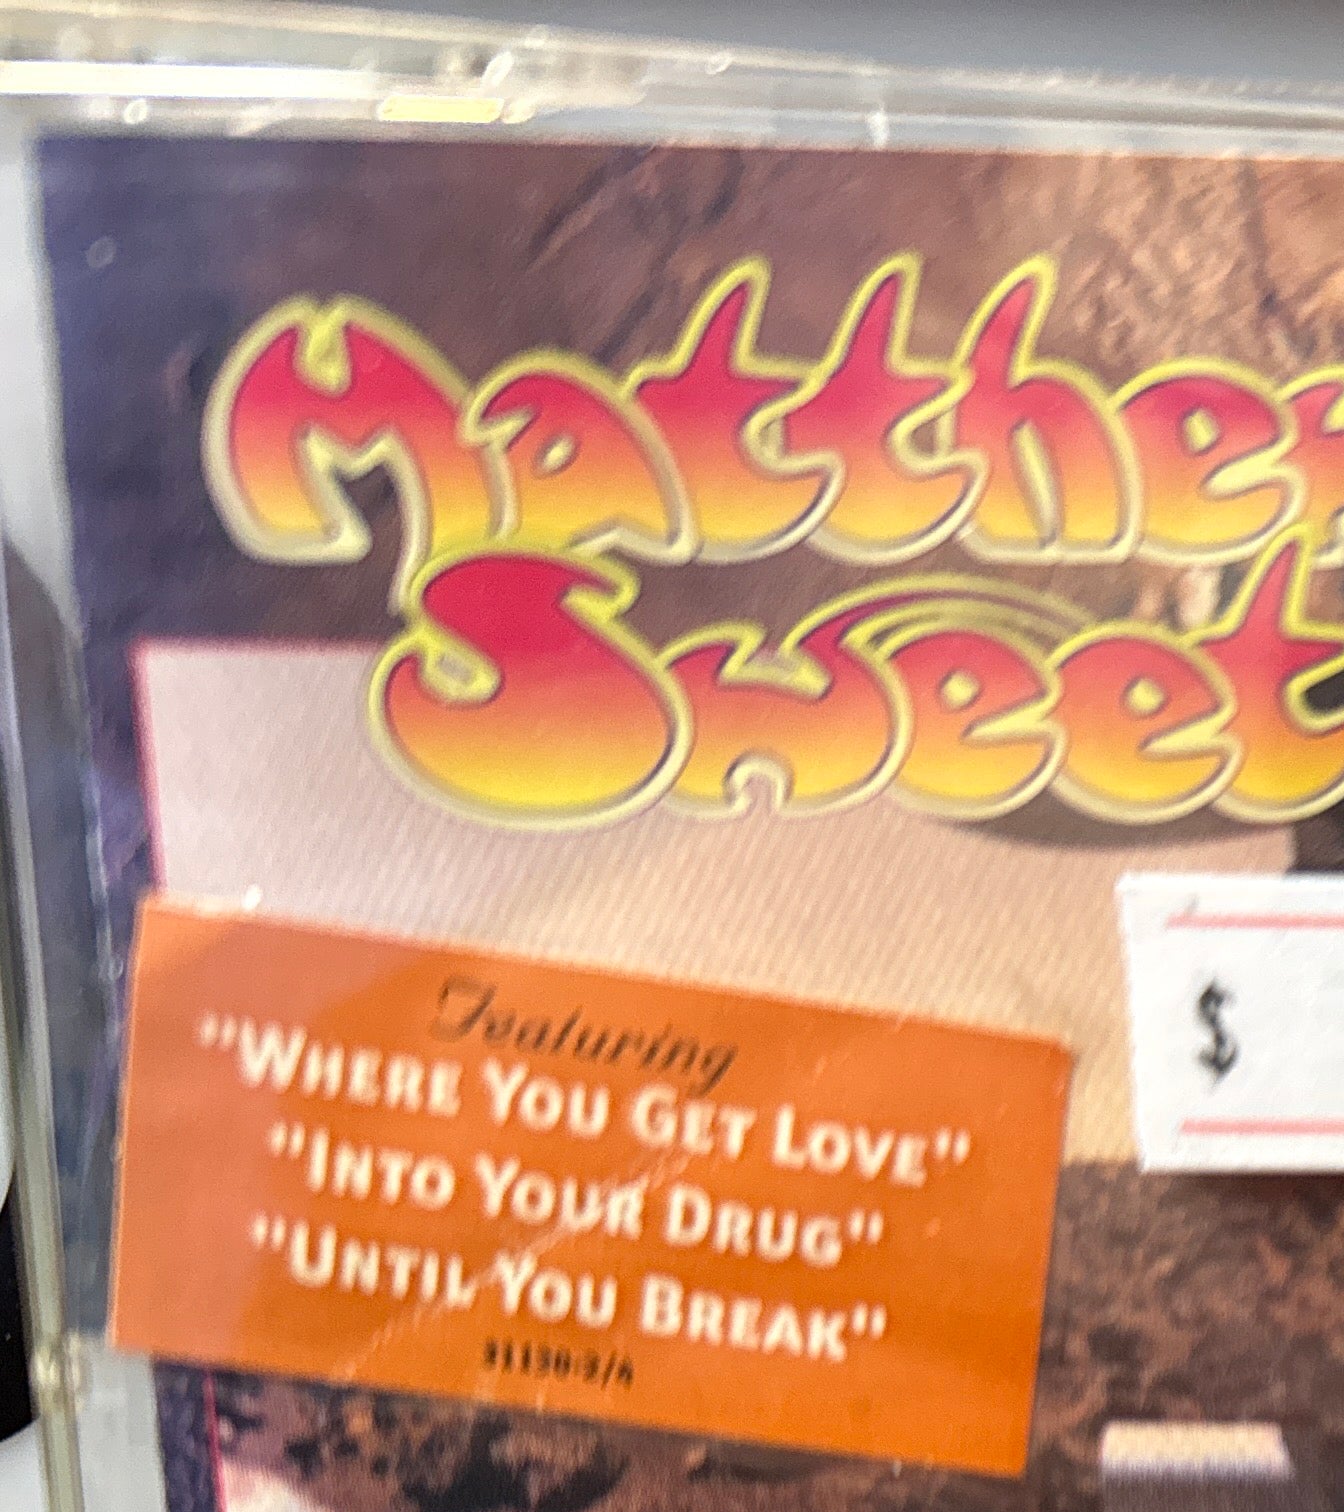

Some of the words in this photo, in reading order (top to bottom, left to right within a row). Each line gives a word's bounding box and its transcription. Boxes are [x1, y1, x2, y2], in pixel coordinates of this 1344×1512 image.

[428, 975, 740, 1097] Featuring
[1197, 976, 1239, 1083] $
[482, 1055, 613, 1141] YOU
[630, 1080, 757, 1162] GET
[475, 1150, 648, 1242] YOUR
[497, 1248, 620, 1330] YOU
